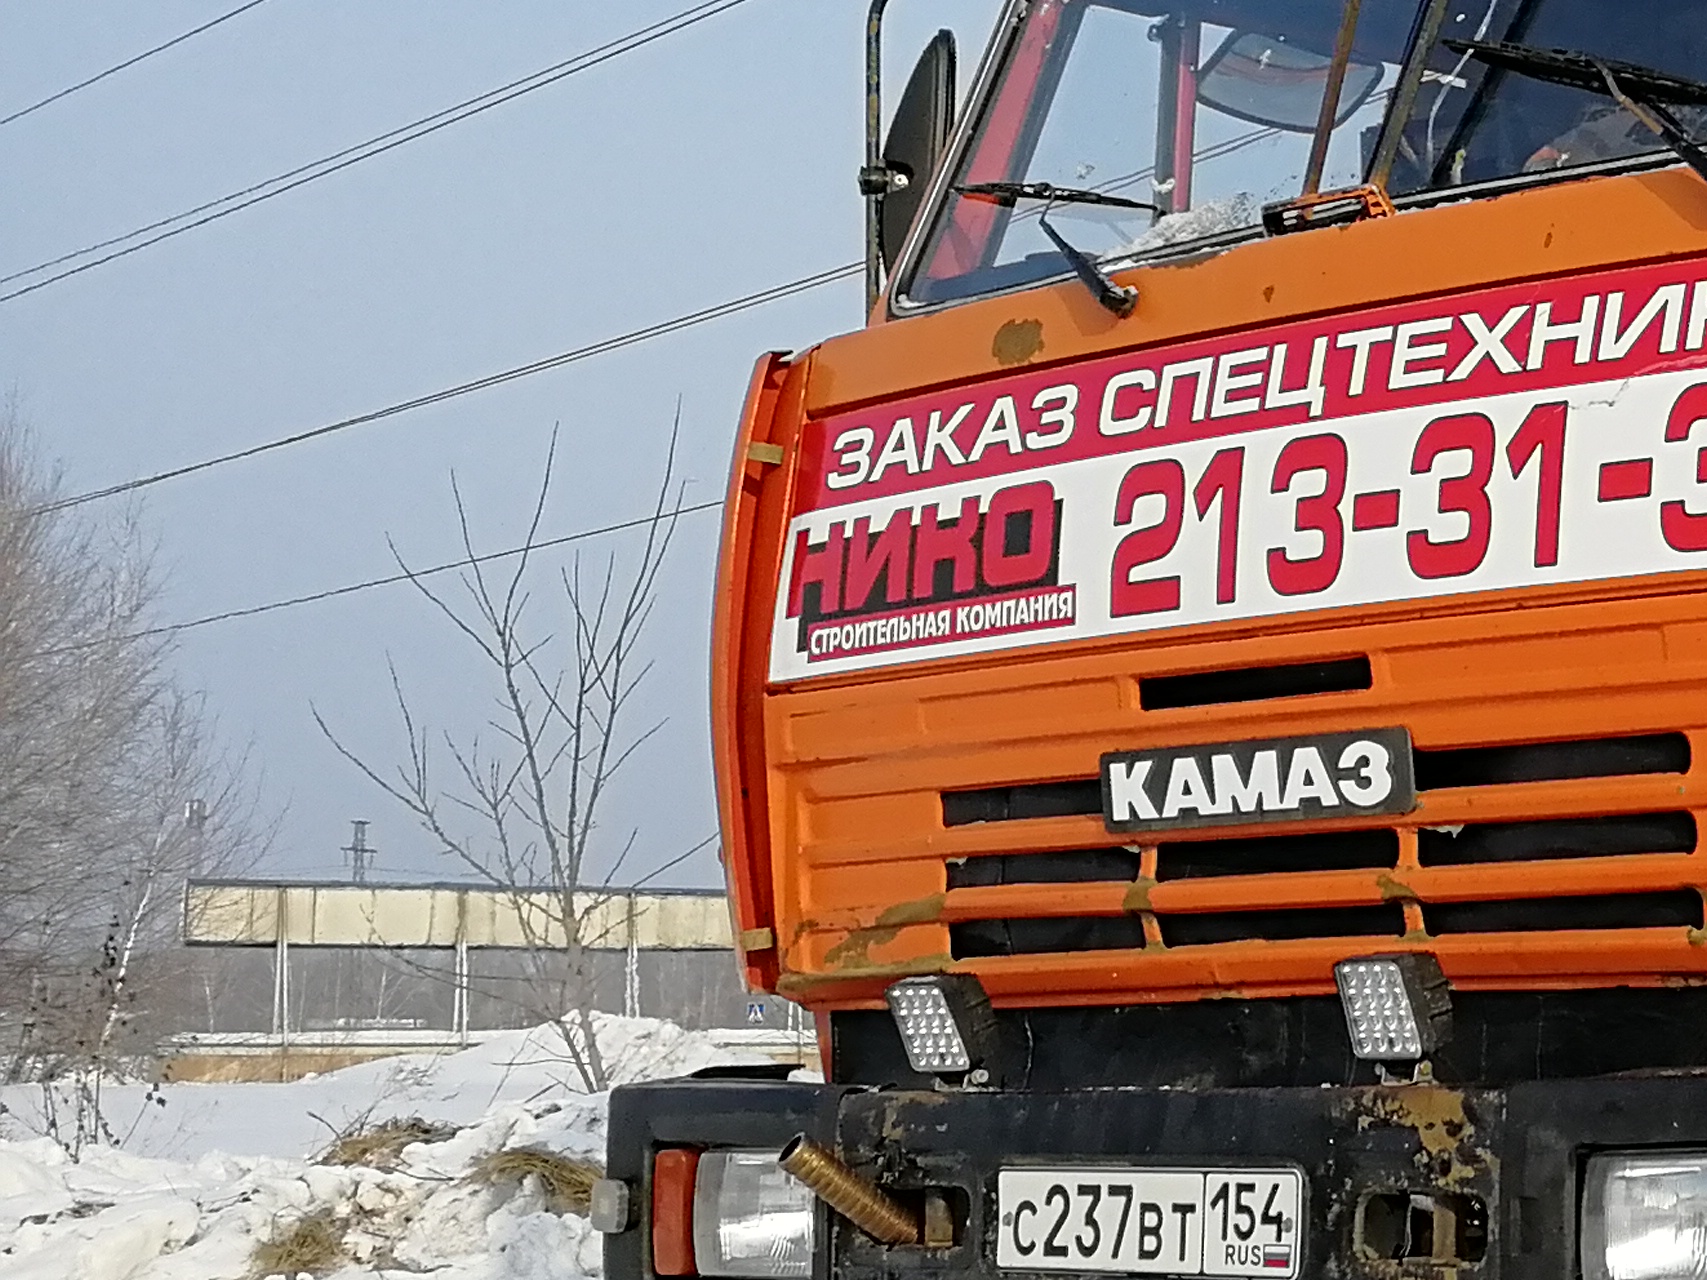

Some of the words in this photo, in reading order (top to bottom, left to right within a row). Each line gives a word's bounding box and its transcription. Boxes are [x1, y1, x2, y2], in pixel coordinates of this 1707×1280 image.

[825, 380, 1078, 492] ЗАКАЗ
[786, 479, 1058, 620] НИКО
[809, 608, 951, 656] СТРОИТЕЛЬНАЯ
[955, 590, 1073, 634] КОМПАНИЯ
[1108, 739, 1393, 822] КАМАЗ
[1209, 1181, 1285, 1243] 154
[1224, 1243, 1262, 1266] RUS
